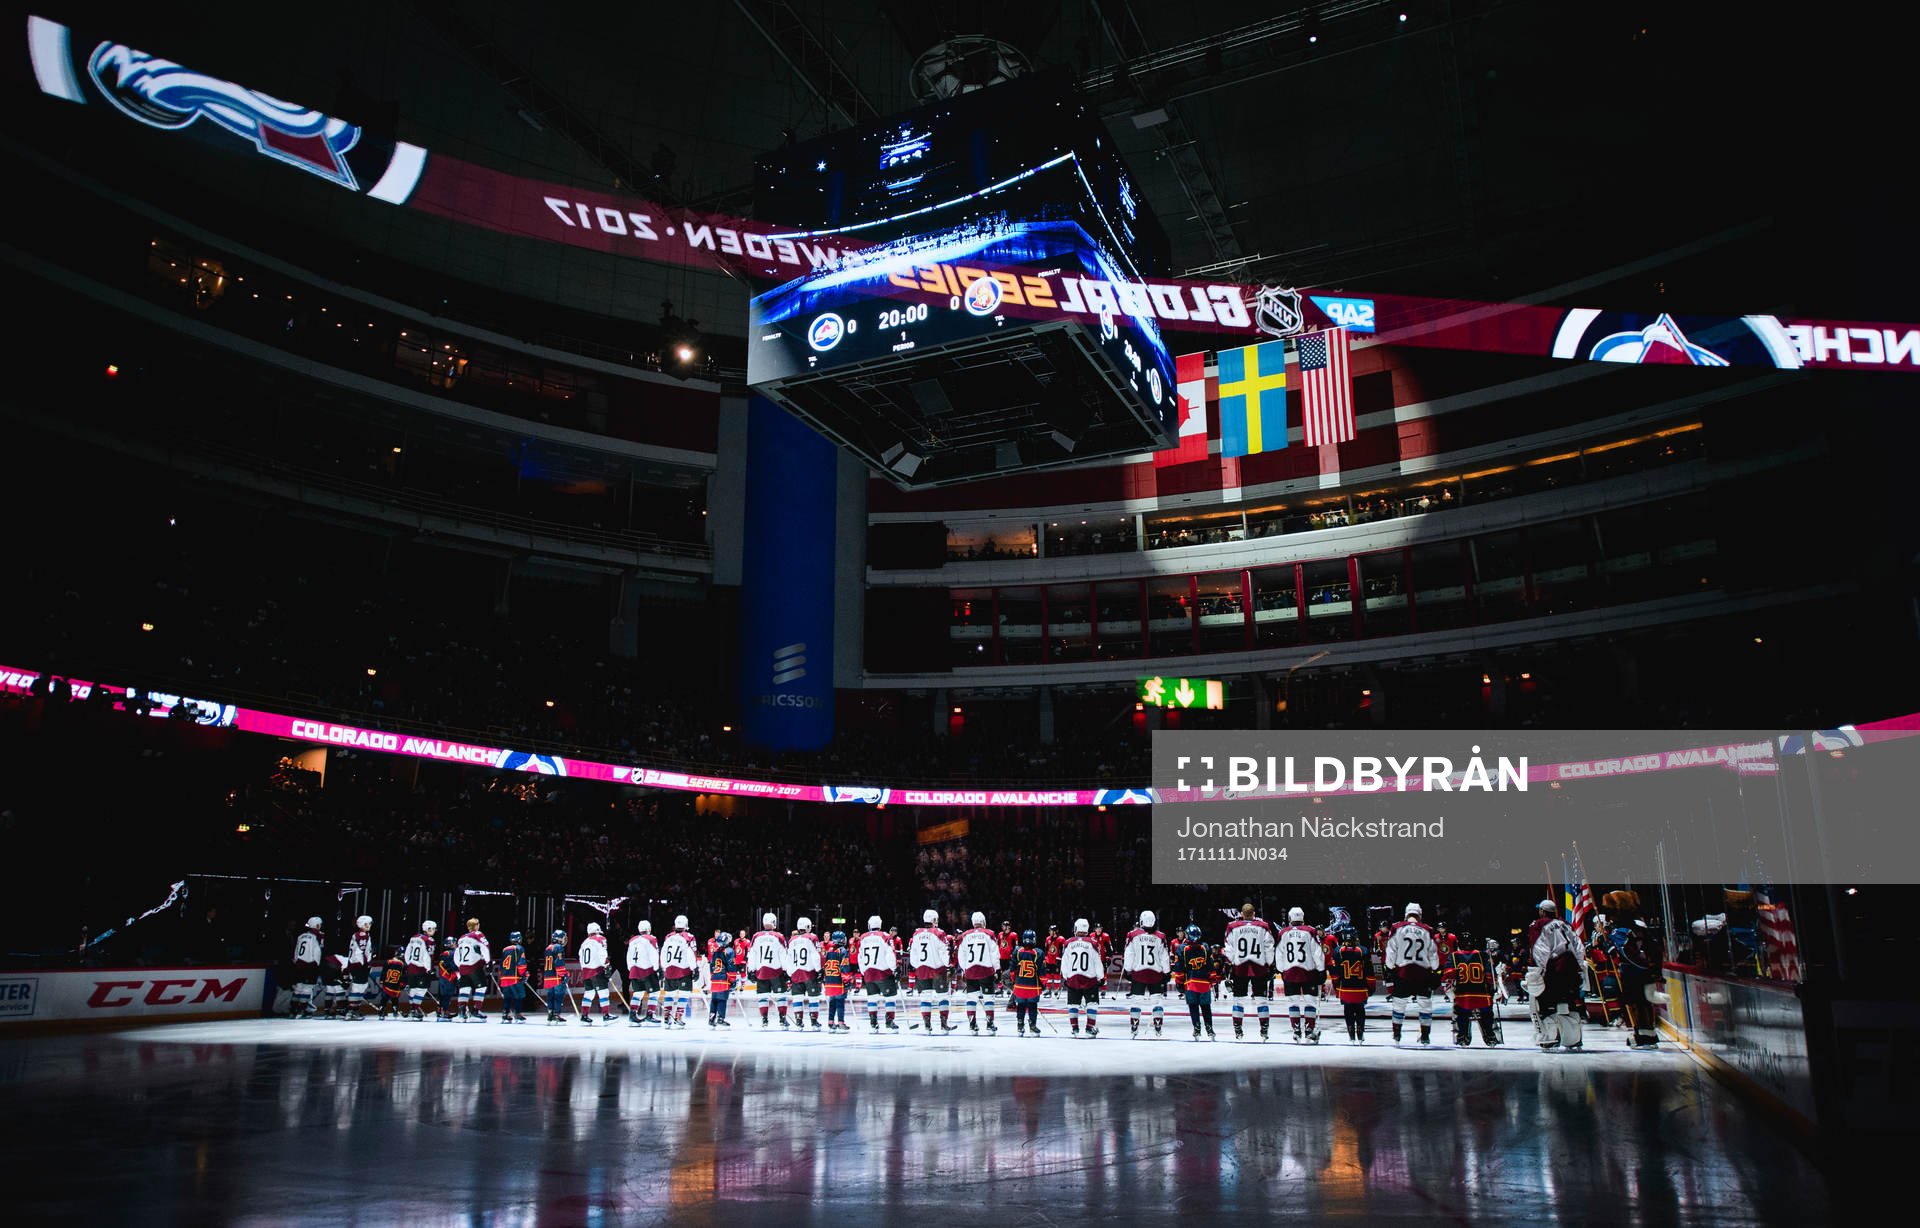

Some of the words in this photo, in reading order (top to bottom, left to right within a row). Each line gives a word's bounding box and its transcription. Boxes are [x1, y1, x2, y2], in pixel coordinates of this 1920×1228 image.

[950, 295, 960, 311] 0
[878, 303, 928, 330] 20:00
[847, 319, 857, 334] 0
[900, 331, 906, 341] 1
[892, 341, 915, 352] PERIOD
[759, 693, 823, 709] RICSSO
[292, 720, 397, 750] COLORADO
[1559, 755, 1661, 778] COLORADO
[689, 777, 731, 791] SERIES
[777, 787, 801, 796] 2017
[905, 792, 986, 804] COLORADO
[990, 792, 1078, 804] AVALANCHE
[298, 941, 306, 956] 6
[667, 946, 682, 963] 64
[760, 946, 773, 963] 14
[864, 946, 880, 965] 57
[920, 943, 928, 962] 3
[968, 943, 986, 962] 37
[1141, 945, 1155, 966] 13
[1237, 938, 1261, 959] 94
[1286, 942, 1306, 963] 83
[1404, 937, 1425, 961] 22
[502, 955, 512, 970] 4
[826, 960, 840, 976] 25
[1018, 960, 1035, 978] 15
[1071, 952, 1089, 971] 20
[1341, 960, 1364, 979] 14
[1457, 963, 1485, 984] 30
[86, 977, 248, 1008] CCM
